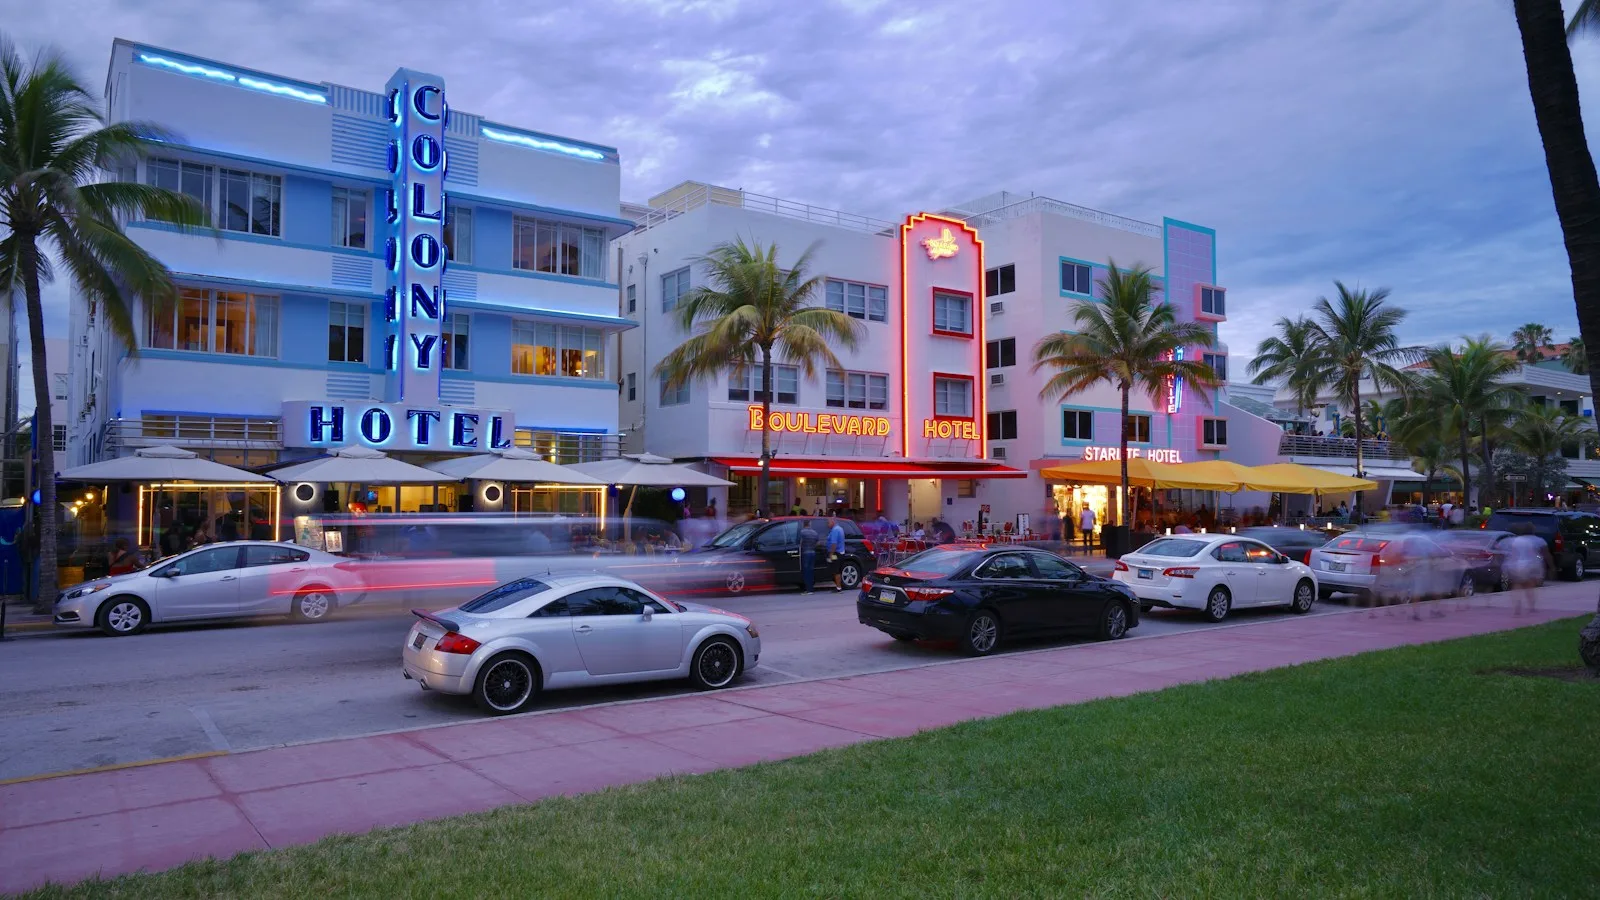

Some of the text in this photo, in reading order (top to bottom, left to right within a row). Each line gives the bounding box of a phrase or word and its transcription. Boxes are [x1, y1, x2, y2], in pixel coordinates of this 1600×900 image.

[410, 84, 441, 369] COLONY
[310, 406, 511, 449] HOTEL
[748, 405, 981, 440] BOULEVARD HOTEL
[1085, 446, 1182, 463] STARLTE HOTEL
